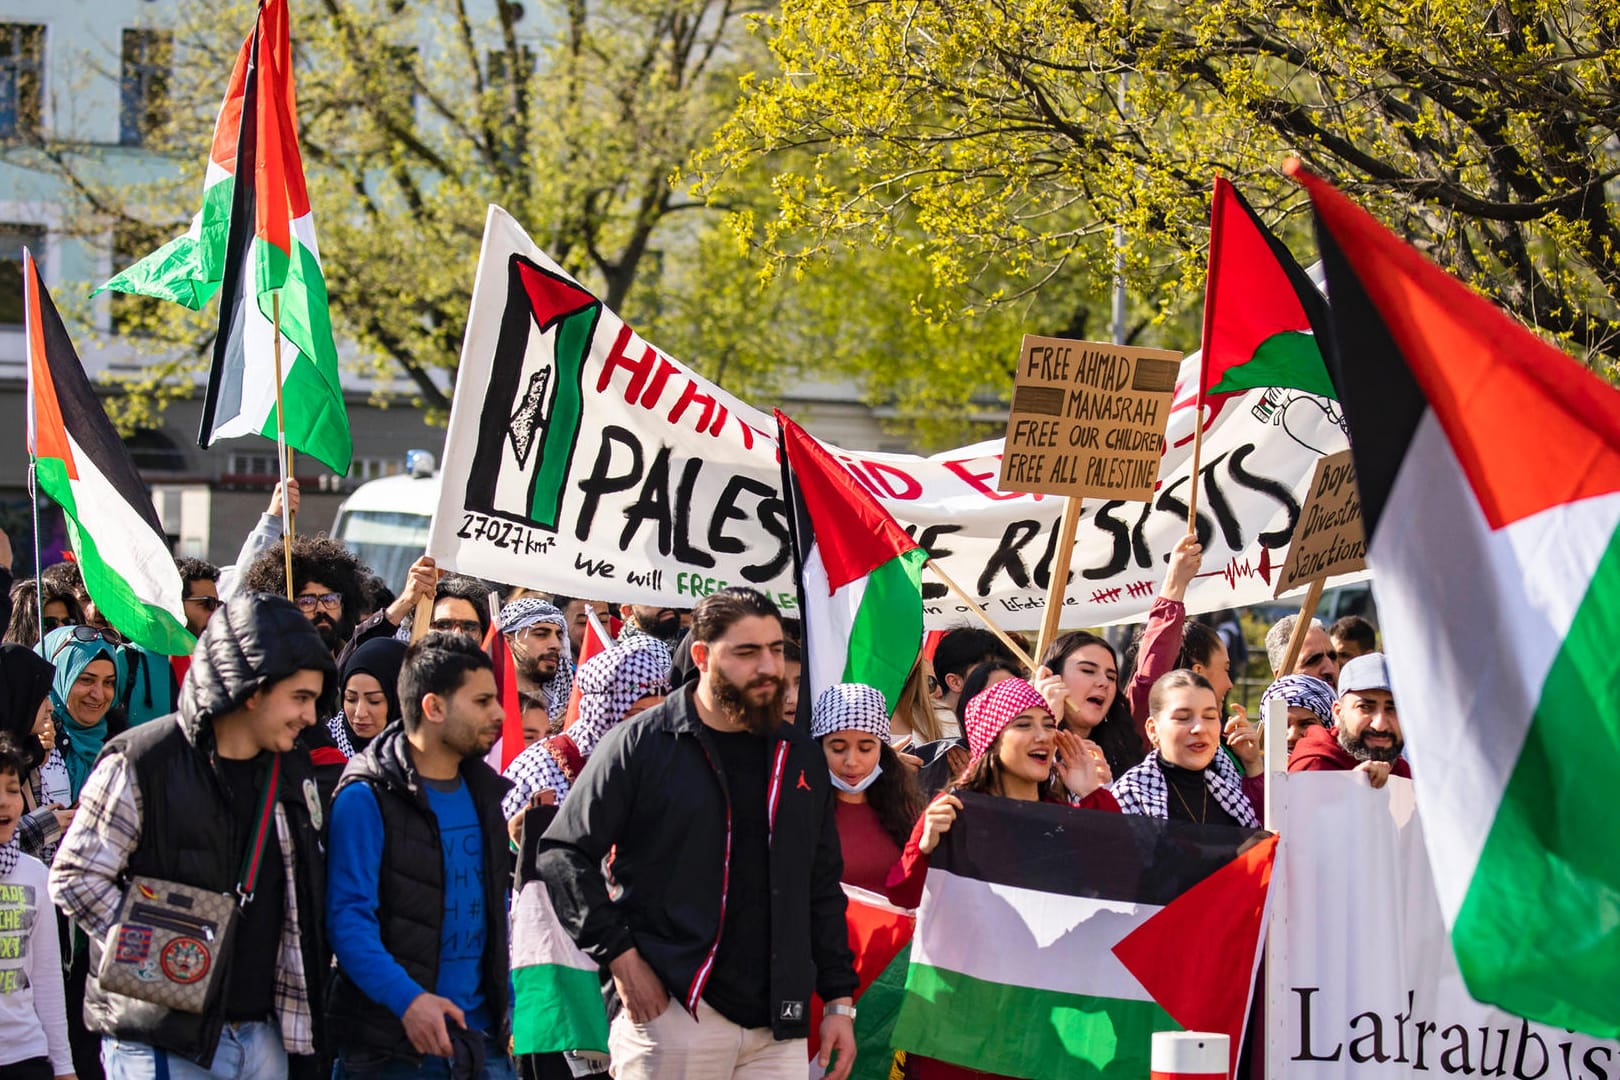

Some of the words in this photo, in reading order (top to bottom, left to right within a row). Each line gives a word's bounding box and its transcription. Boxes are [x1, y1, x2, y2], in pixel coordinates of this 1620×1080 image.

[1027, 346, 1072, 381] FREE
[1074, 350, 1131, 392] AHMAD
[1066, 389, 1159, 427] MANASRAH
[1013, 420, 1060, 447] FREE
[1069, 425, 1099, 450] OUR
[1105, 428, 1165, 452] CHILDREN
[1007, 453, 1046, 483] FREE
[1049, 455, 1078, 484] ALL
[1085, 455, 1157, 489] PALESTINE
[575, 426, 963, 599] PALESE
[1288, 532, 1367, 583] Sanctions
[627, 569, 662, 590] will
[955, 601, 990, 613] or
